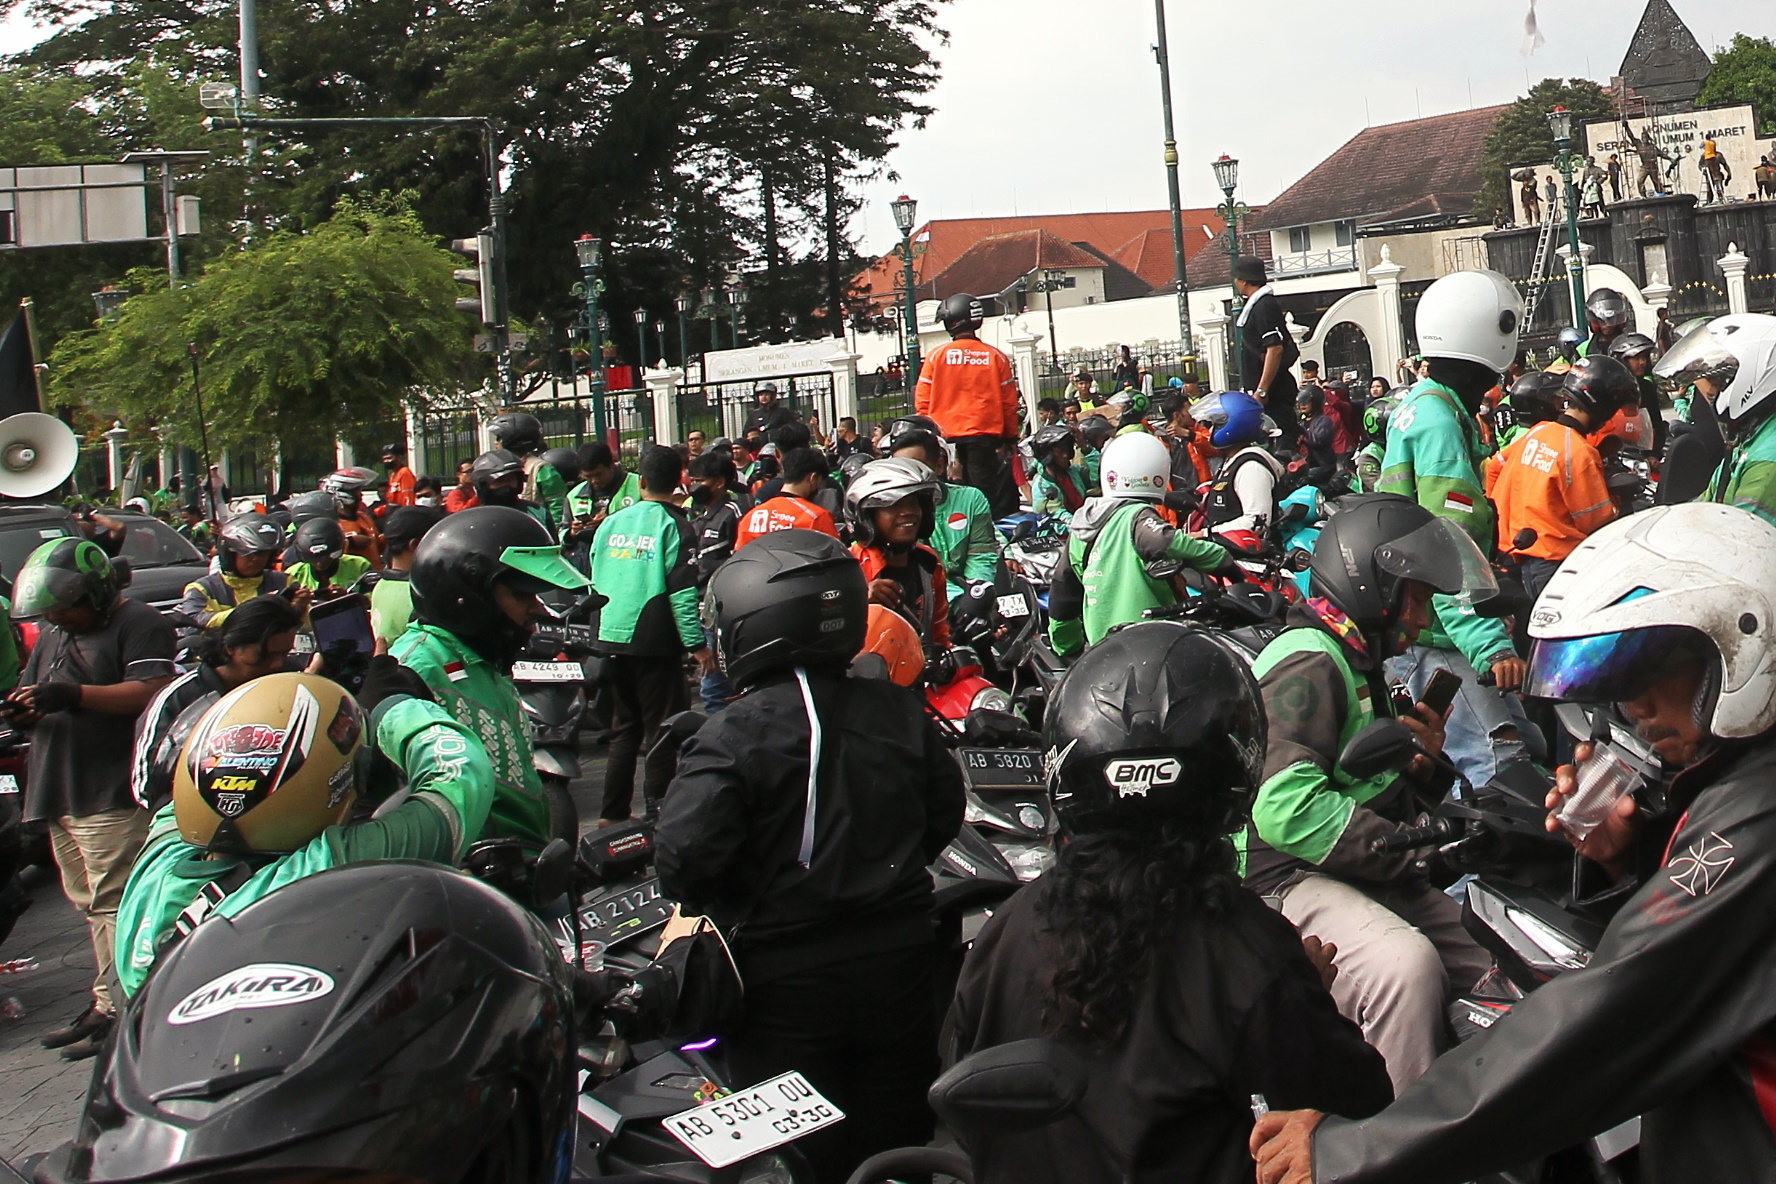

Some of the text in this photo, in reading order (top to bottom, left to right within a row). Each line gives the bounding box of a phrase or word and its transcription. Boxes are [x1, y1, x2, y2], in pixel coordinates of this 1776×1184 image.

[1642, 120, 1698, 134] MONUMEN
[1662, 133, 1694, 144] UMUM
[1708, 126, 1747, 138] MARET
[964, 356, 990, 365] Food
[1740, 388, 1753, 408] ALV
[969, 753, 1032, 768] AB 5820
[1114, 760, 1176, 784] BMC
[211, 775, 257, 791] KTM
[948, 850, 977, 876] HONDA
[606, 884, 662, 918] 2124
[676, 1116, 714, 1141] AB
[710, 1092, 777, 1127] 5301
